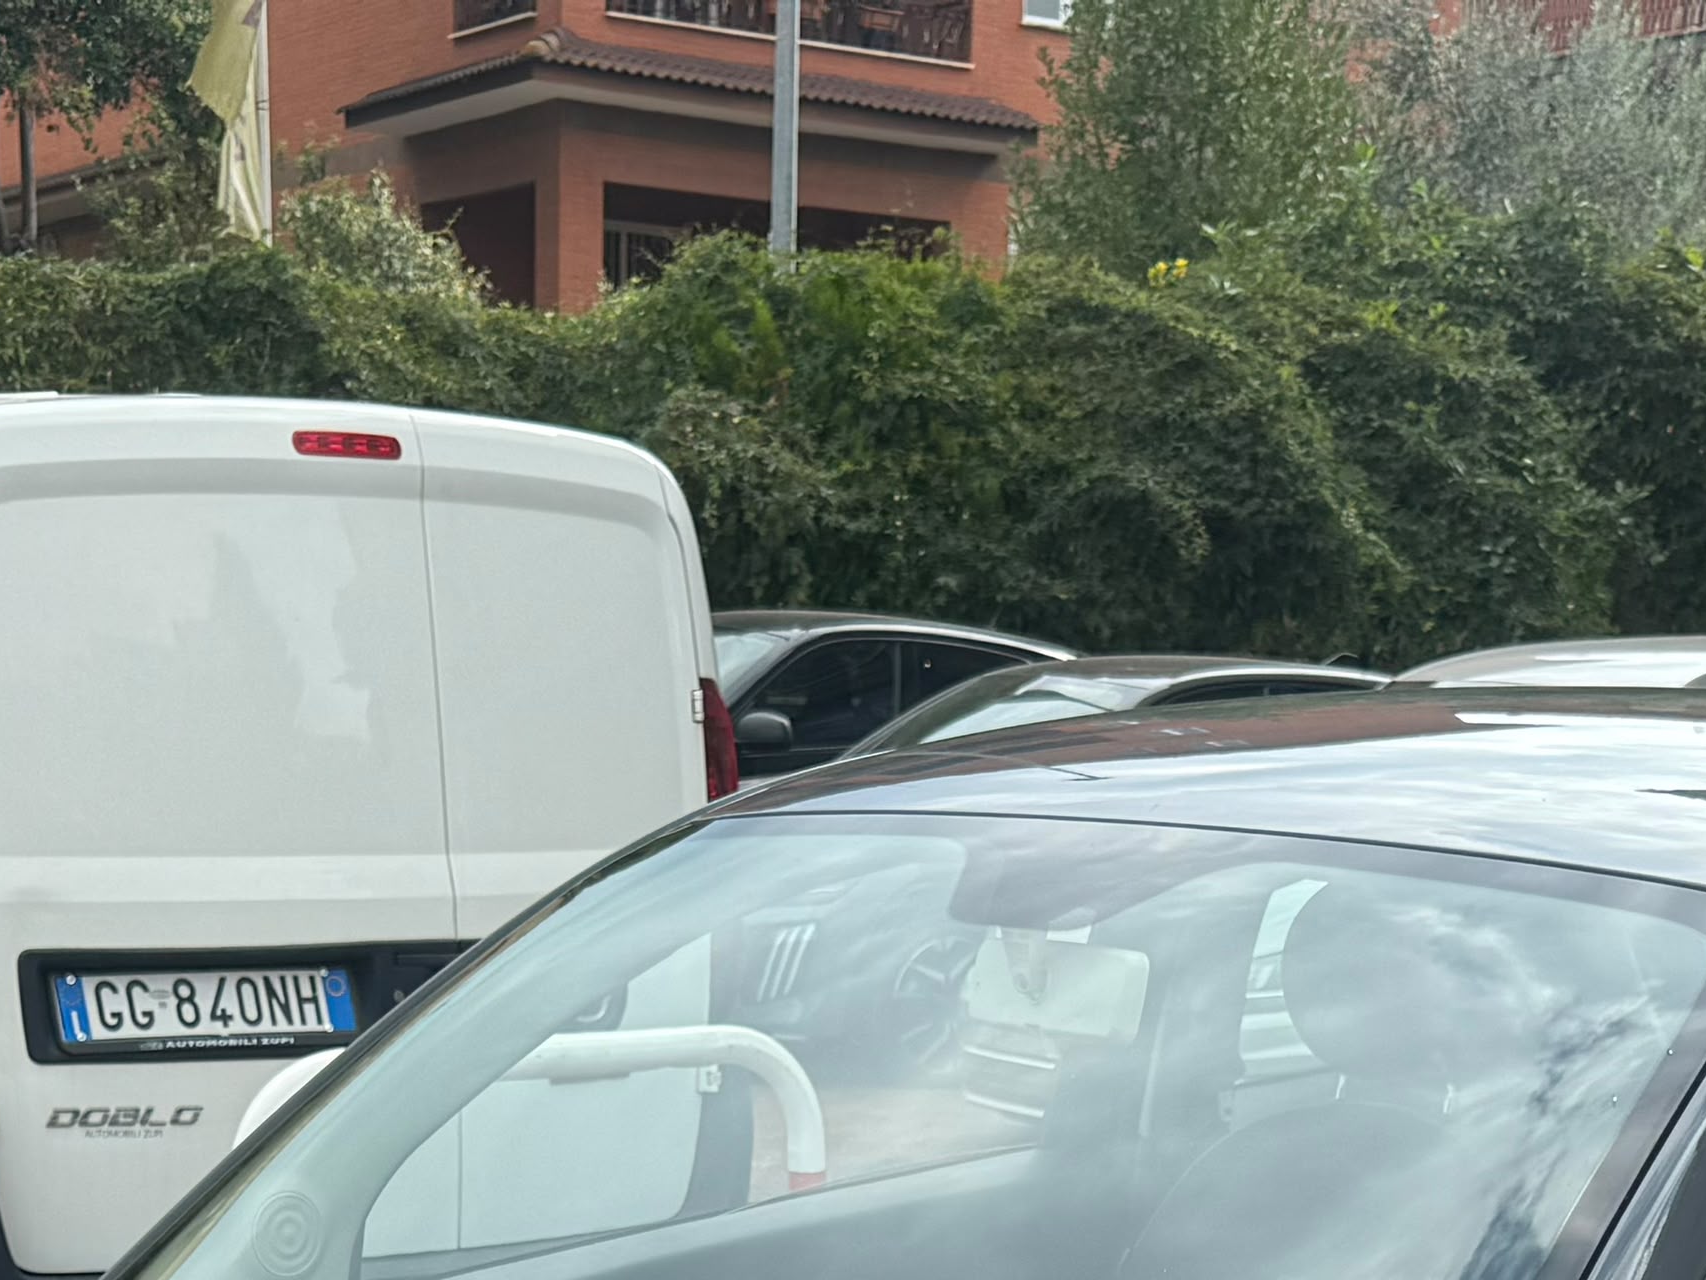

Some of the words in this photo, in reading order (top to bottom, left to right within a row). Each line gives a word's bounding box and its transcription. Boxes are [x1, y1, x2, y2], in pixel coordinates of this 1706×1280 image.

[95, 979, 156, 1032] GG
[172, 974, 325, 1029] 840NH
[165, 1038, 258, 1049] AUTOMOBILI
[260, 1036, 296, 1046] ZUPI
